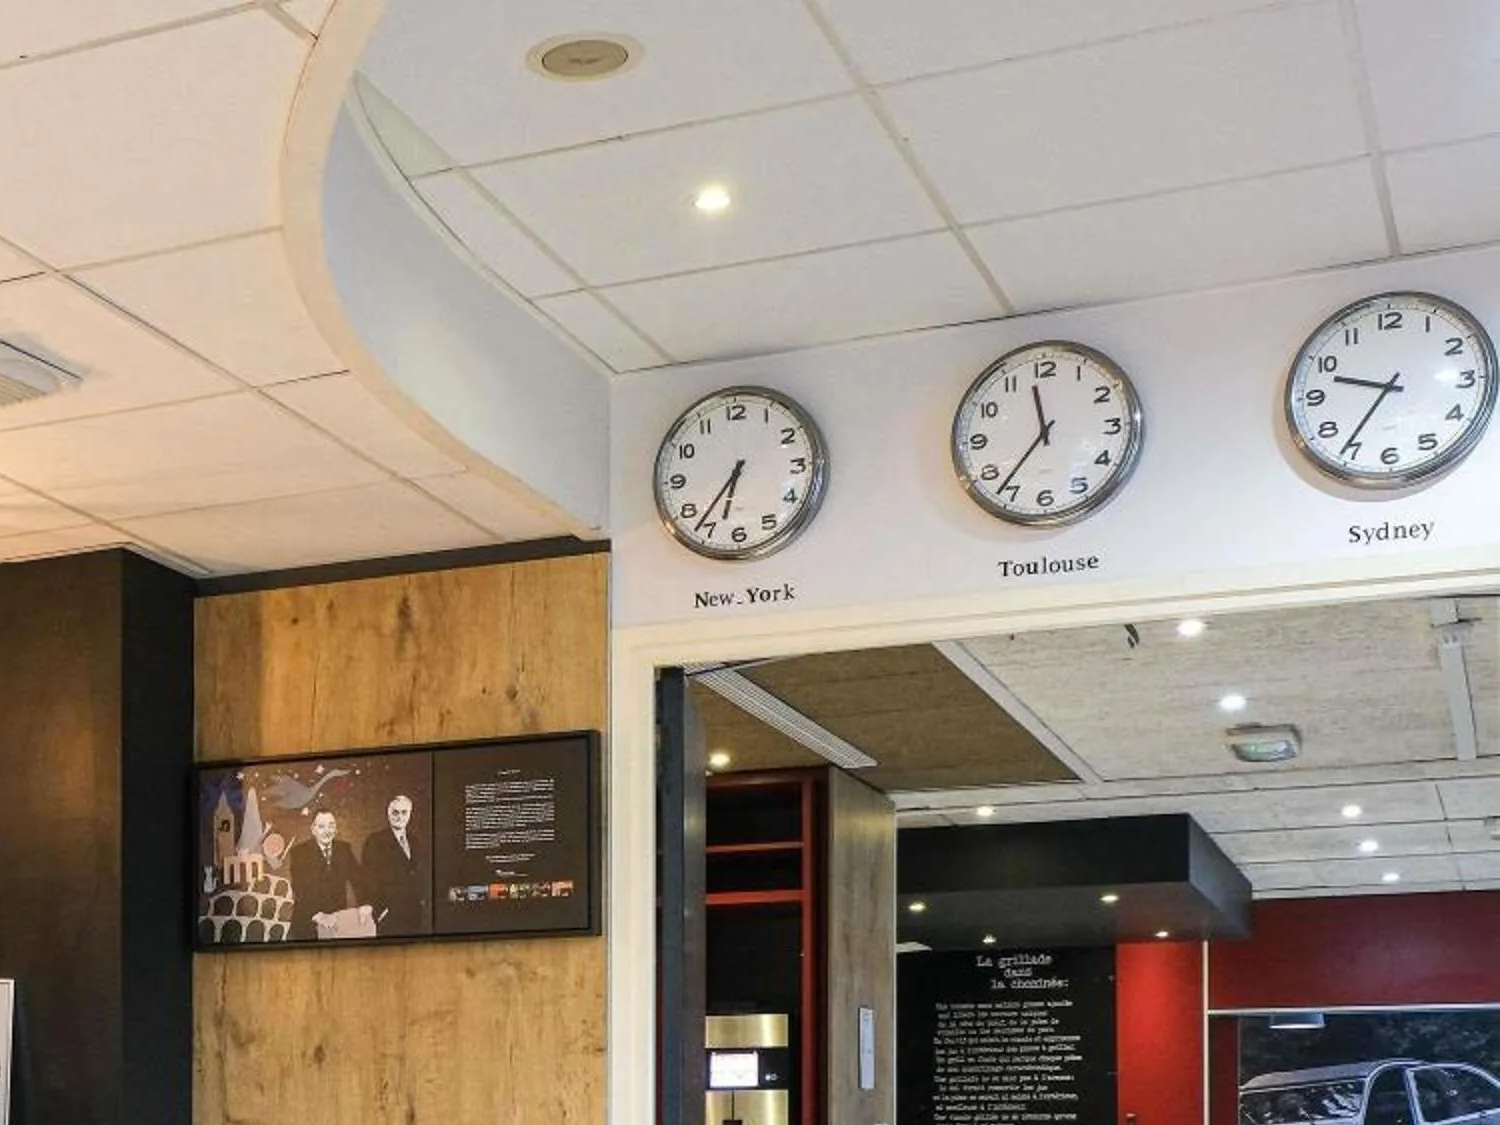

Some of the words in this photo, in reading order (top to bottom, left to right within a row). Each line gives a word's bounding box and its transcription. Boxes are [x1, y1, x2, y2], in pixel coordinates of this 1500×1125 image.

[1377, 311, 1403, 331] 12
[1345, 327, 1359, 346] 11
[1444, 337, 1463, 356] 2
[1034, 361, 1057, 379] 12
[1318, 355, 1337, 373] 10
[1004, 376, 1017, 393] 11
[1456, 370, 1476, 389] 3
[1093, 386, 1111, 404] 2
[1305, 389, 1326, 407] 9
[726, 404, 746, 421] 12
[981, 401, 998, 419] 10
[1445, 403, 1464, 422] 4
[700, 419, 711, 435] 11
[1102, 418, 1122, 435] 3
[1317, 421, 1339, 438] 8
[780, 427, 795, 445] 2
[970, 433, 988, 450] 9
[1417, 433, 1438, 451] 5
[679, 443, 695, 460] 10
[1094, 450, 1112, 466] 4
[1349, 441, 1362, 461] 7
[1380, 447, 1399, 464] 6
[790, 457, 806, 474] 3
[980, 464, 999, 481] 8
[669, 474, 686, 490] 9
[1070, 477, 1088, 494] 5
[783, 488, 798, 504] 4
[1005, 485, 1021, 502] 7
[1036, 490, 1055, 506] 6
[680, 503, 697, 519] 8
[703, 521, 717, 538] 7
[761, 514, 777, 531] 5
[731, 527, 747, 543] 6
[1347, 518, 1435, 549] Sydney
[998, 554, 1100, 578] Toulouse
